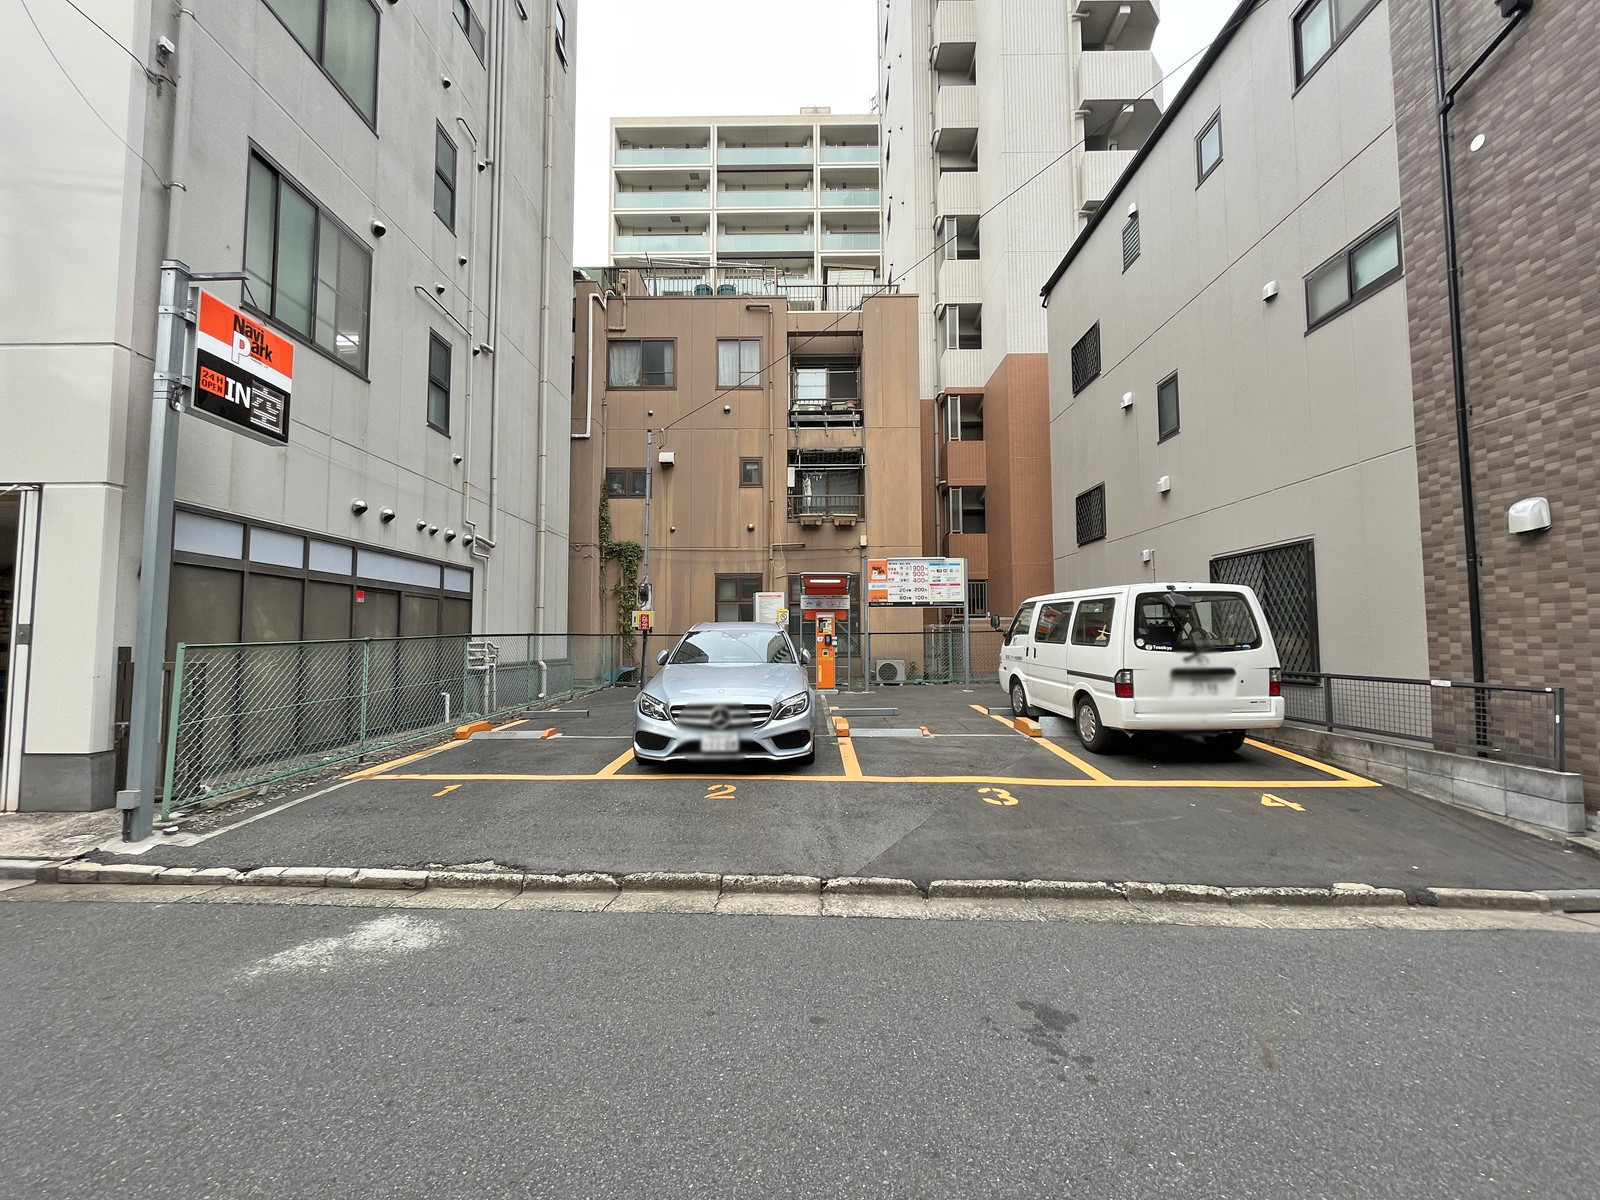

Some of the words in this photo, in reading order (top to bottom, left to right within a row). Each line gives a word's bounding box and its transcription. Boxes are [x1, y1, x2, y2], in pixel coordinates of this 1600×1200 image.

[233, 313, 264, 345] Navi
[231, 330, 273, 365] Park
[201, 379, 223, 394] OPEN
[224, 376, 251, 409] IN
[432, 784, 463, 797] 1
[704, 783, 738, 799] 2
[978, 787, 1019, 806] 3
[1261, 793, 1306, 811] 4
